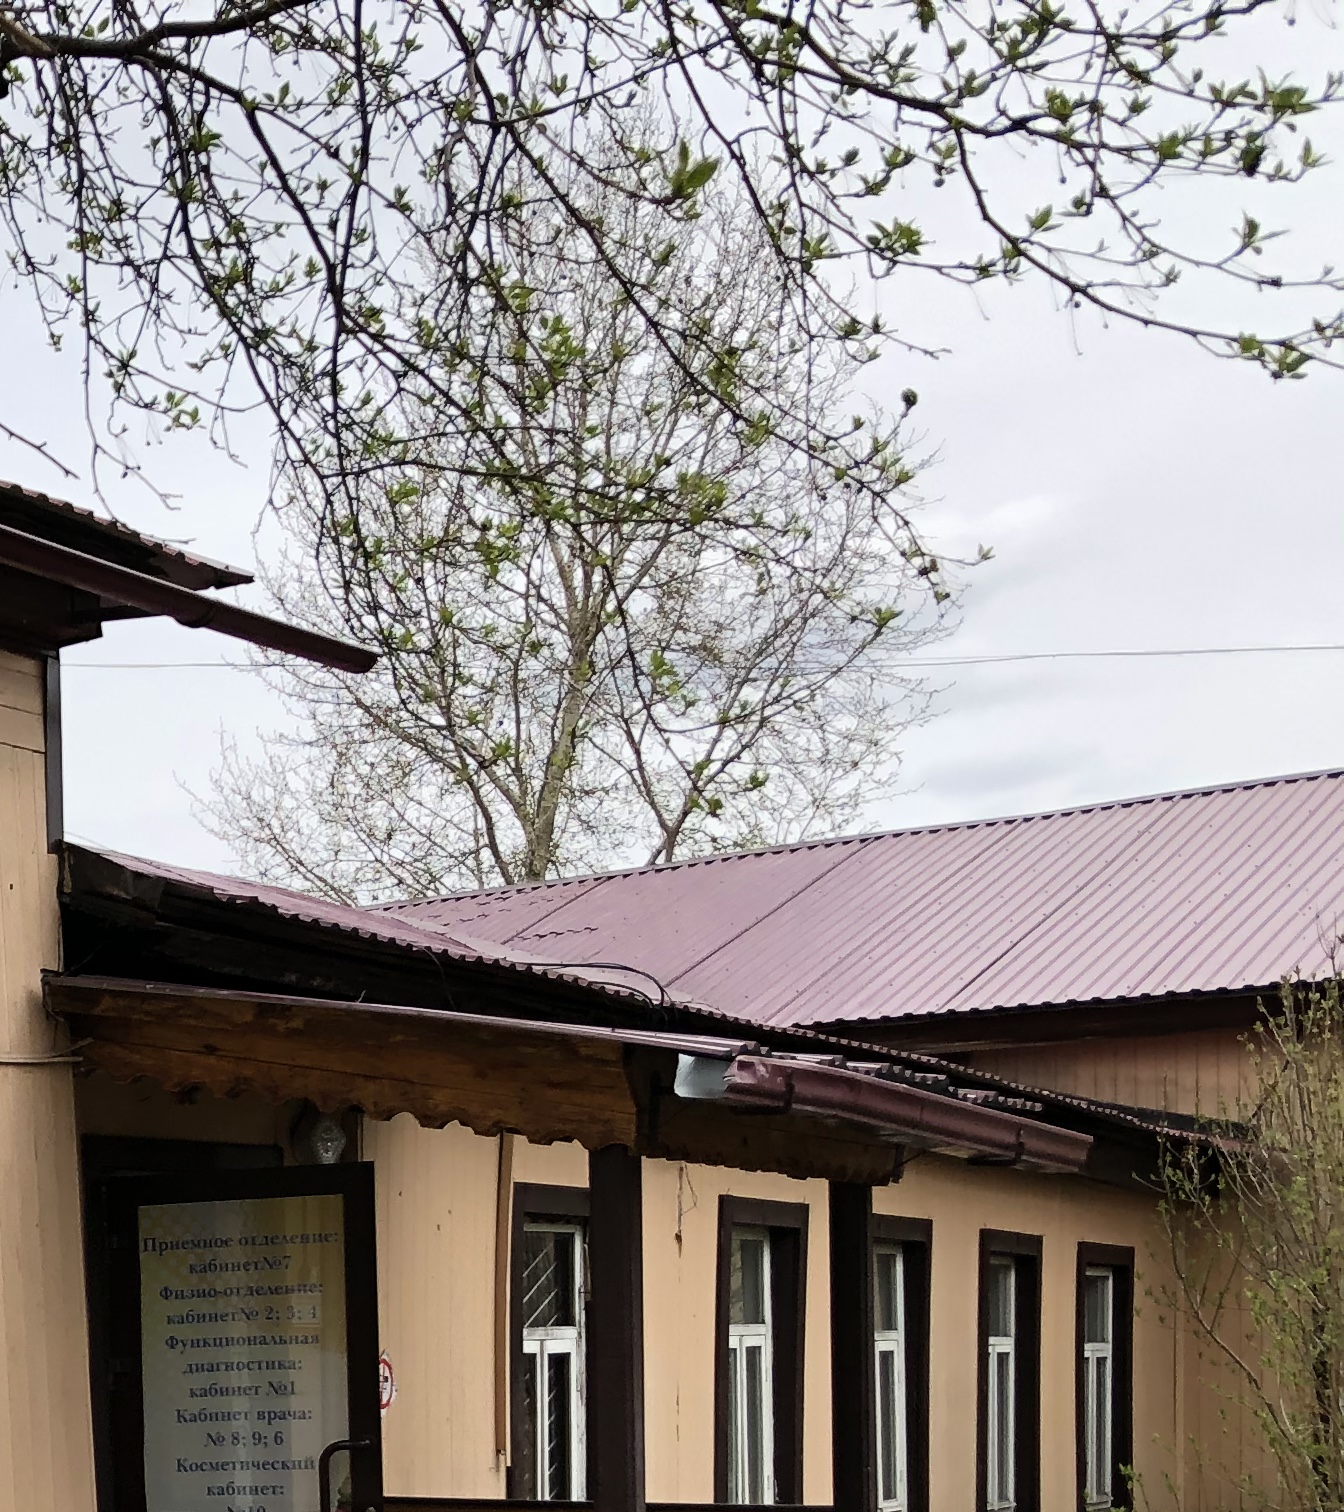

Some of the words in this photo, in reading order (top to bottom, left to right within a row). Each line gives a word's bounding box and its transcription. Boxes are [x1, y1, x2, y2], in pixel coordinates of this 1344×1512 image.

[143, 1236, 233, 1255] Приемное
[239, 1232, 338, 1248] отделение:
[159, 1282, 323, 1301] Физио-отделение:
[264, 1306, 280, 1321] 2;
[165, 1334, 320, 1354] Функциональная
[182, 1359, 303, 1375] диагностика:
[189, 1383, 262, 1399] кабинет
[265, 1381, 296, 1396] №1
[175, 1408, 251, 1424] Кабинет
[256, 1409, 312, 1425] врача:
[203, 1432, 226, 1447] №
[231, 1432, 247, 1447] 8;
[251, 1431, 268, 1447] 9;
[273, 1431, 284, 1446] 6
[176, 1457, 316, 1473] Косметический
[207, 1481, 285, 1496] кабинет:
